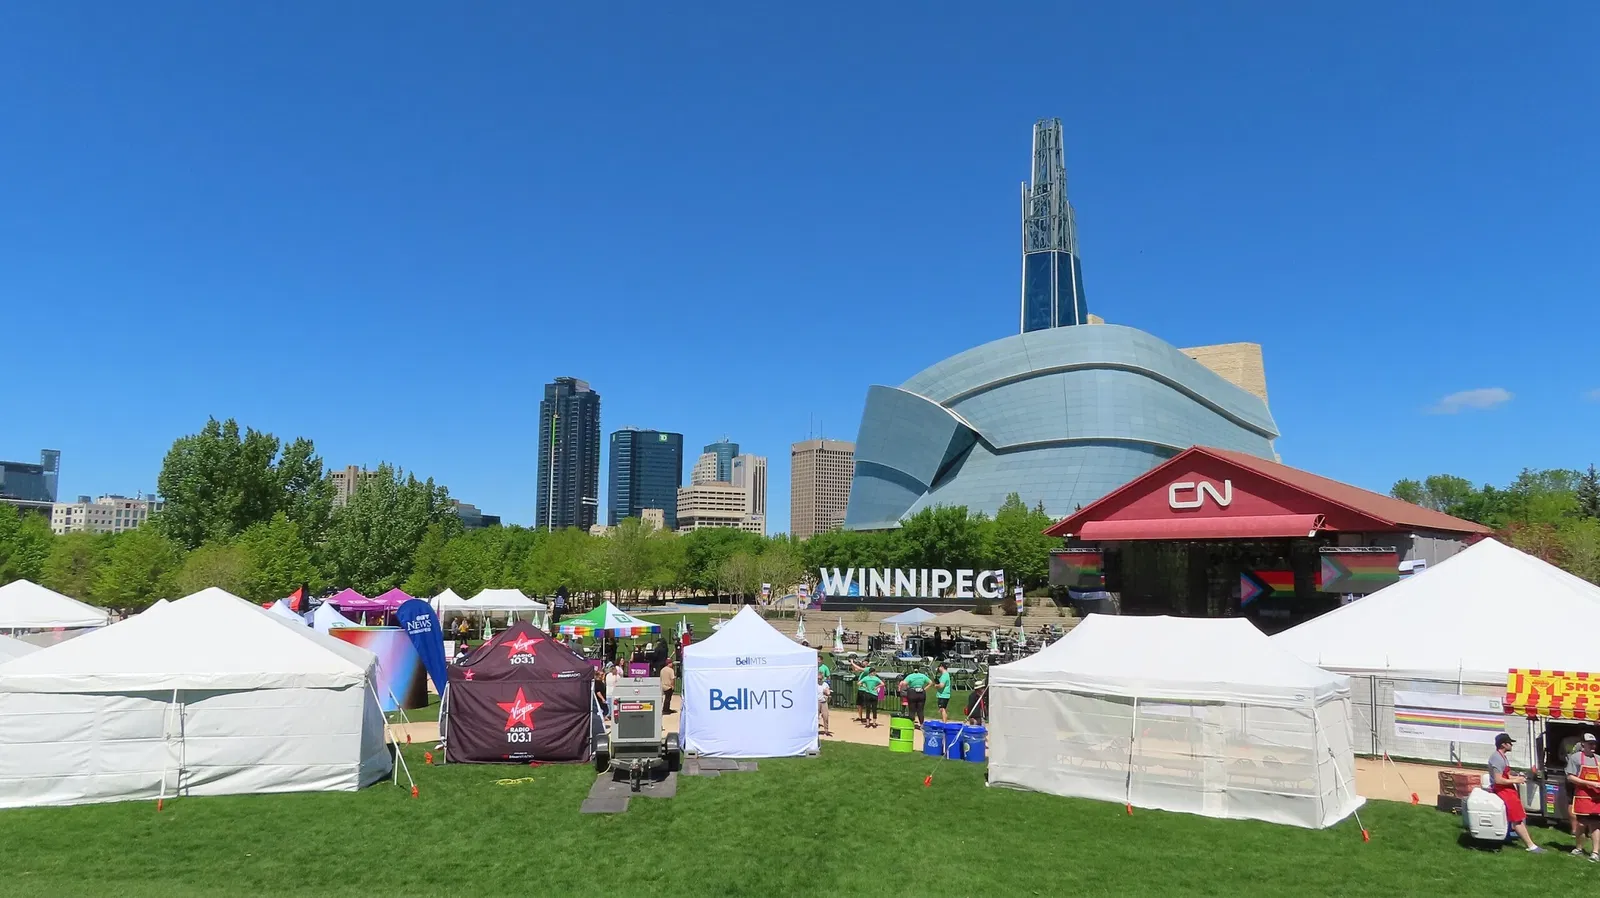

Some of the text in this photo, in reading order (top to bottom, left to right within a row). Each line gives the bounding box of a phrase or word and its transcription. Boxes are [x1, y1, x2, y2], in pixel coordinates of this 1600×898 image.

[1169, 480, 1232, 508] CN
[820, 567, 998, 599] WINNIPEG
[407, 619, 432, 631] NEWS
[513, 638, 535, 651] Virgin
[510, 656, 535, 665] 103.1
[510, 699, 535, 721] Virgin
[506, 731, 532, 743] 103.1
